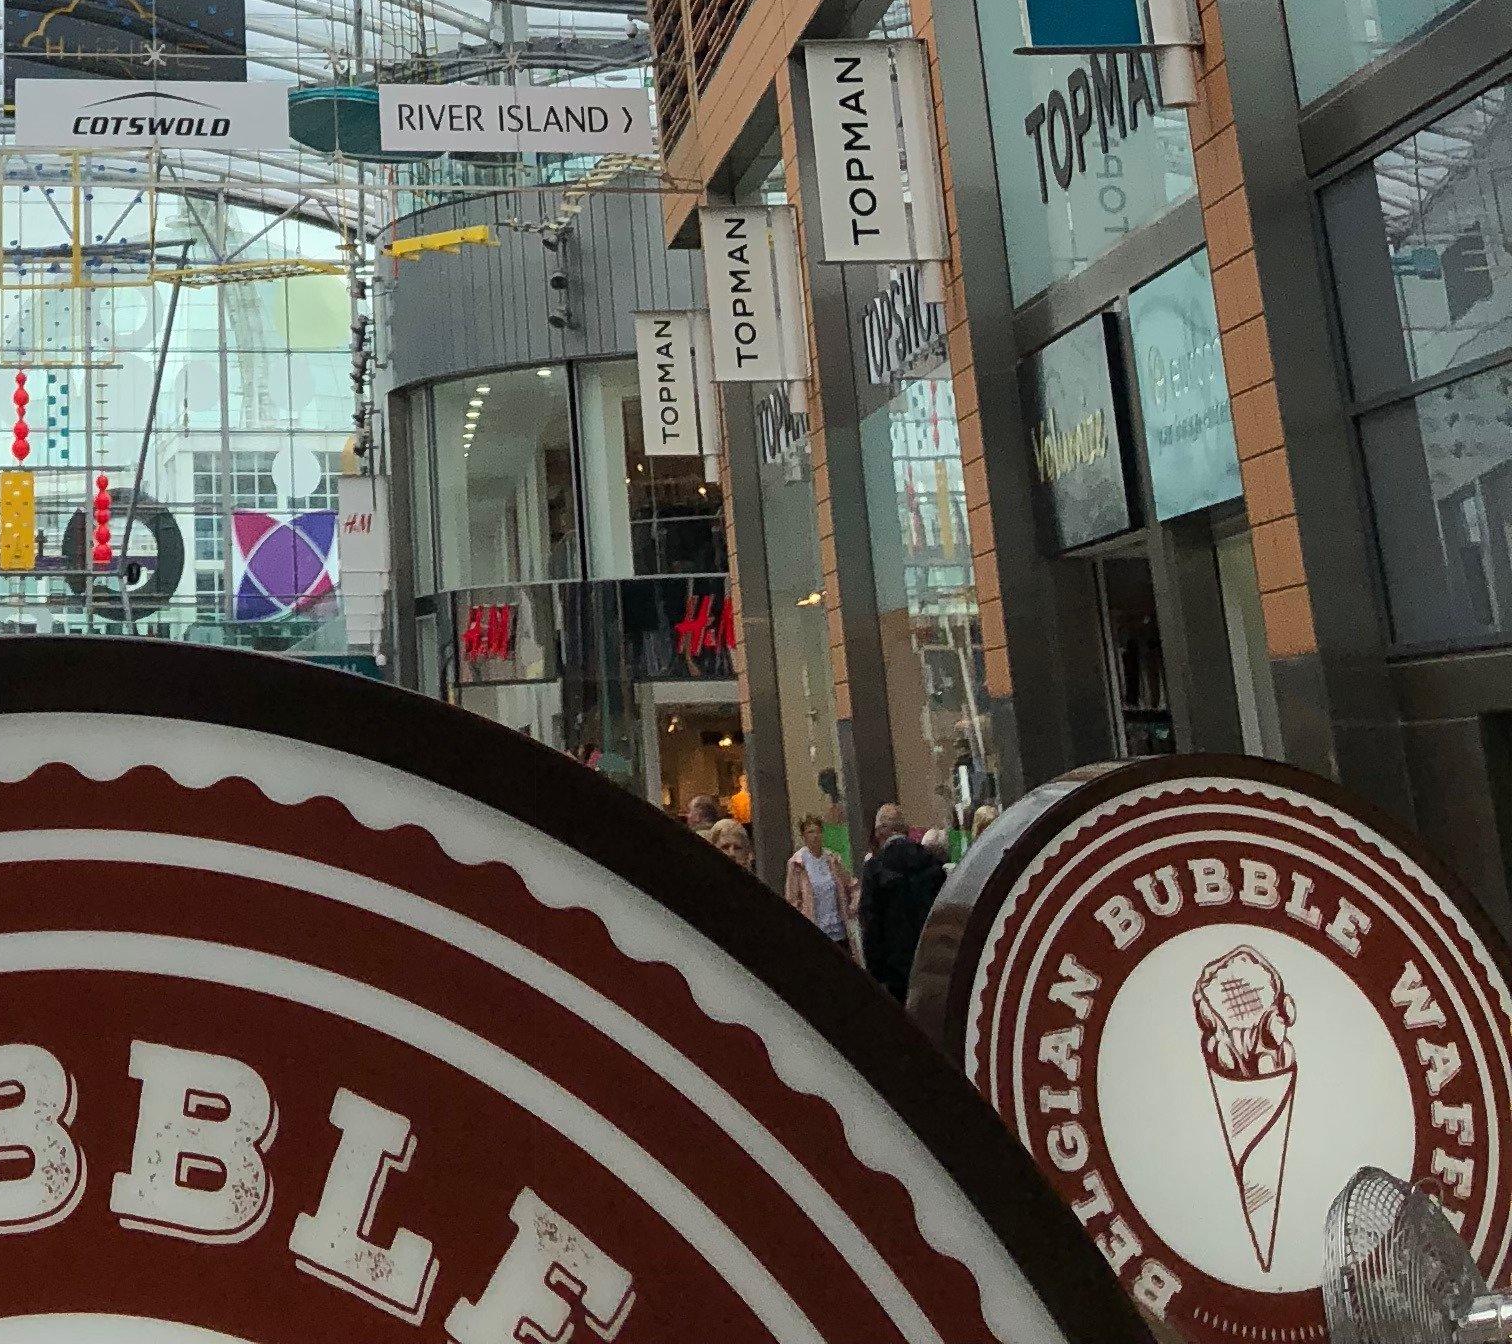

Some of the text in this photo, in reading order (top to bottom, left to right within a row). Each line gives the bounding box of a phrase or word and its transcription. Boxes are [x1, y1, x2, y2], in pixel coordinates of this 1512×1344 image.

[72, 116, 231, 137] COTSWOLD
[397, 104, 609, 133] RIVER ISLAND
[834, 57, 880, 246] TOPMAN
[725, 217, 759, 368] TOPMAN
[653, 320, 680, 444] TOPMAN
[1039, 858, 1475, 1322] BELGIAN BUBBLE WAFF
